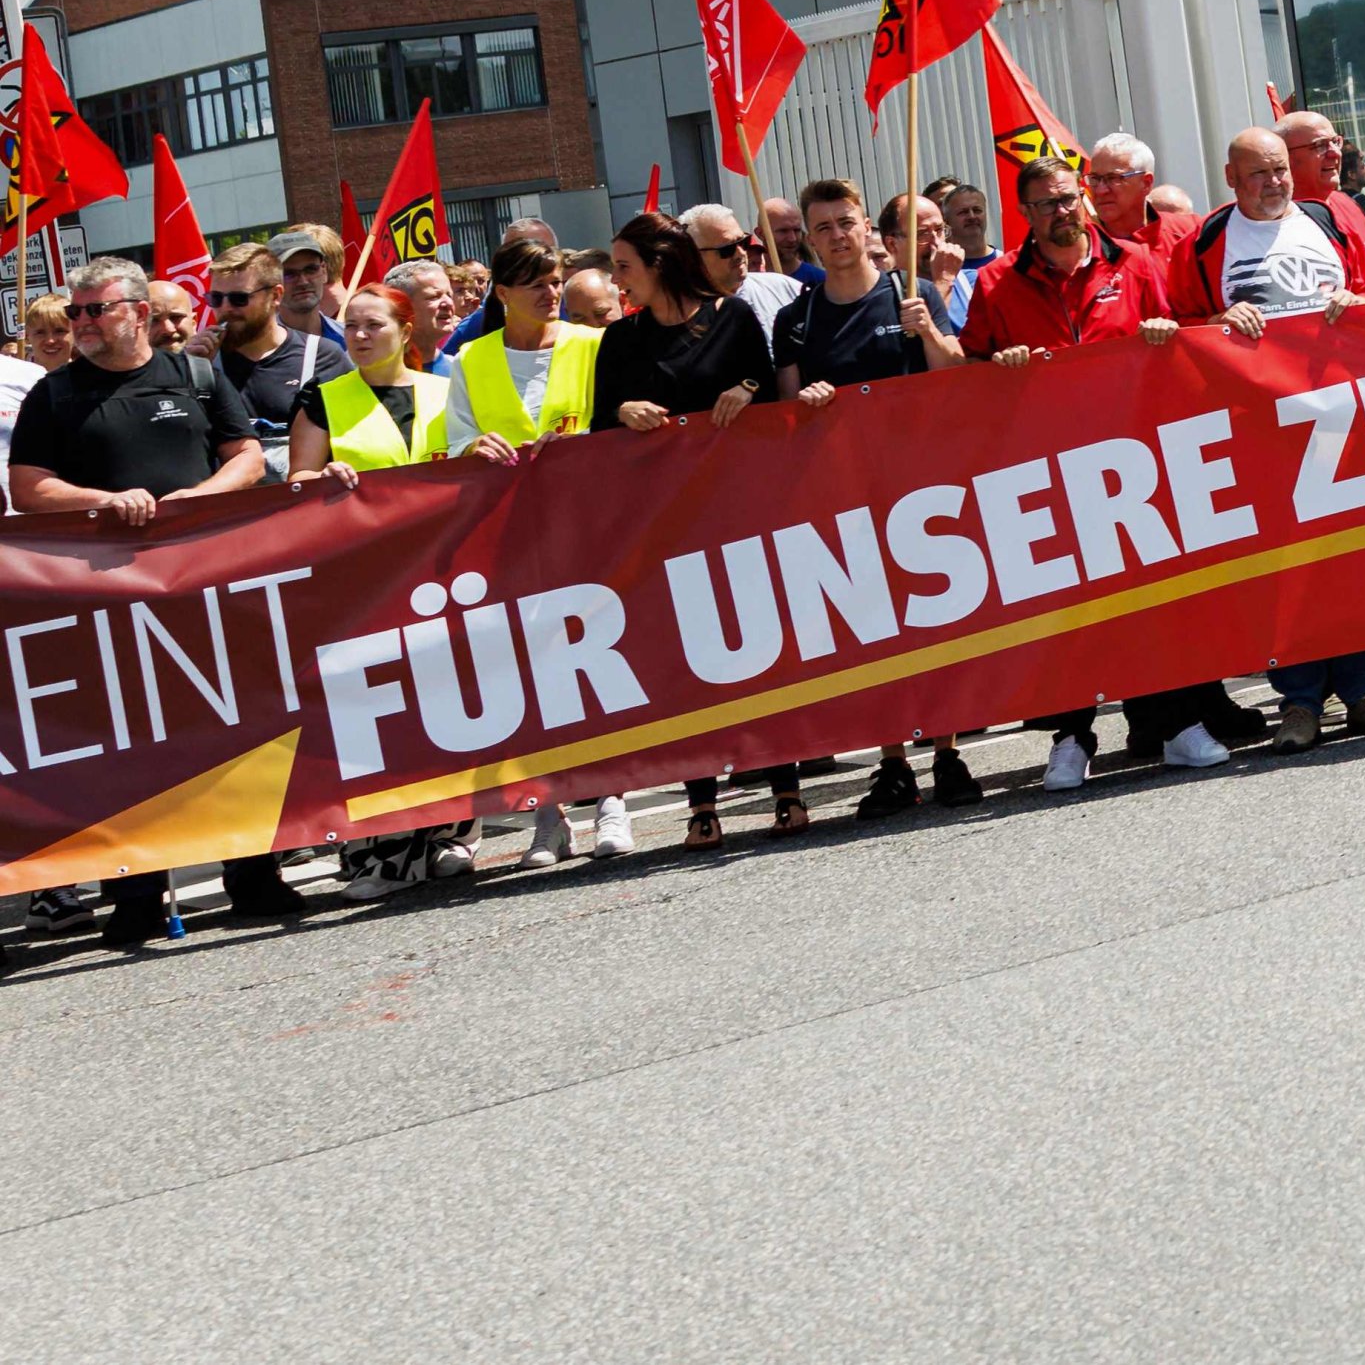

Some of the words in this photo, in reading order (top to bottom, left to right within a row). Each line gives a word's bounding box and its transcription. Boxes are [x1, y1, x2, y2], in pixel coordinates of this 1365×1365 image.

[0, 566, 312, 776] EINT
[315, 571, 650, 781] FÜR
[664, 408, 1260, 684] UNSERE
